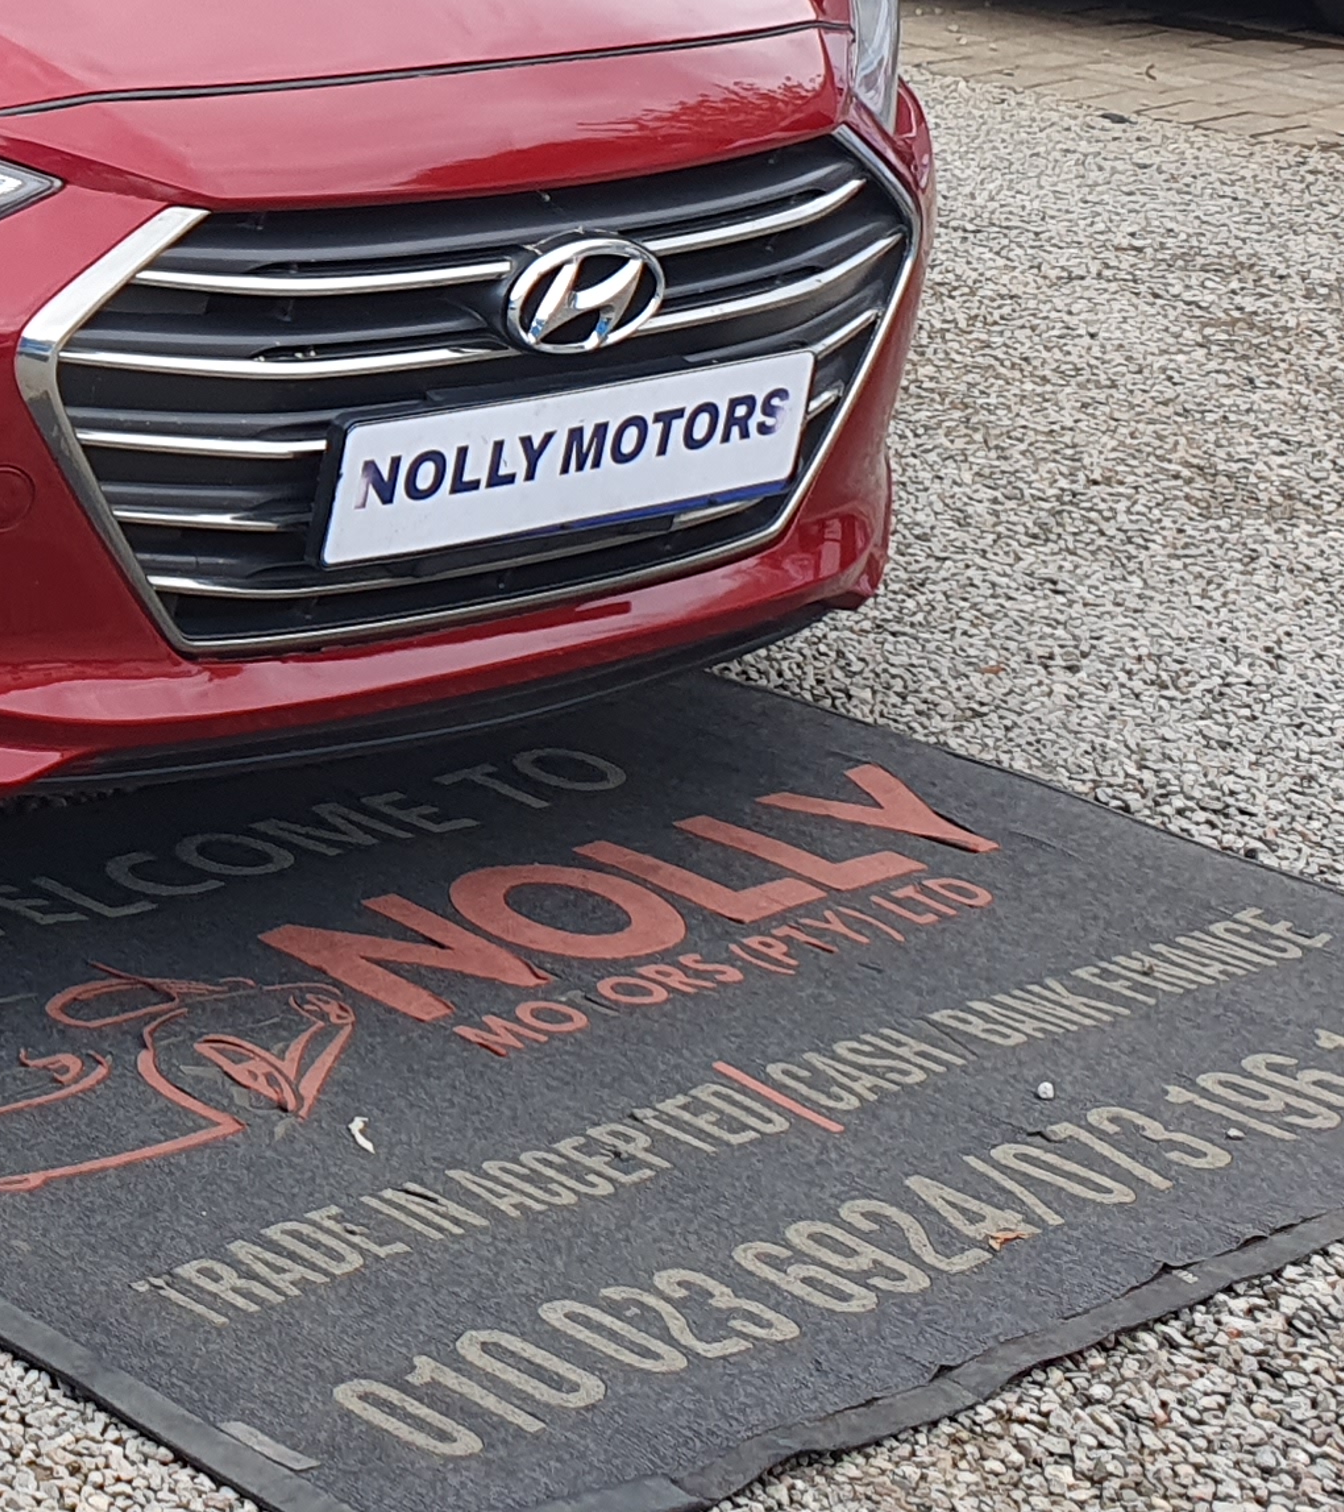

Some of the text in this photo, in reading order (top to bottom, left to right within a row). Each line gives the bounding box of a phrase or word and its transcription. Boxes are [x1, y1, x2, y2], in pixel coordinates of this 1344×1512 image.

[354, 387, 791, 510] NOLLY MOTORS
[435, 746, 627, 808] TO
[258, 763, 1000, 1022] NOLLY
[728, 906, 906, 975] (PTY)
[869, 877, 994, 925] LTD
[128, 1205, 413, 1326] TRADE
[360, 1181, 490, 1240] IN
[1070, 906, 1333, 1006] FINANCE
[332, 1329, 607, 1457] 010
[538, 1268, 801, 1373] 023
